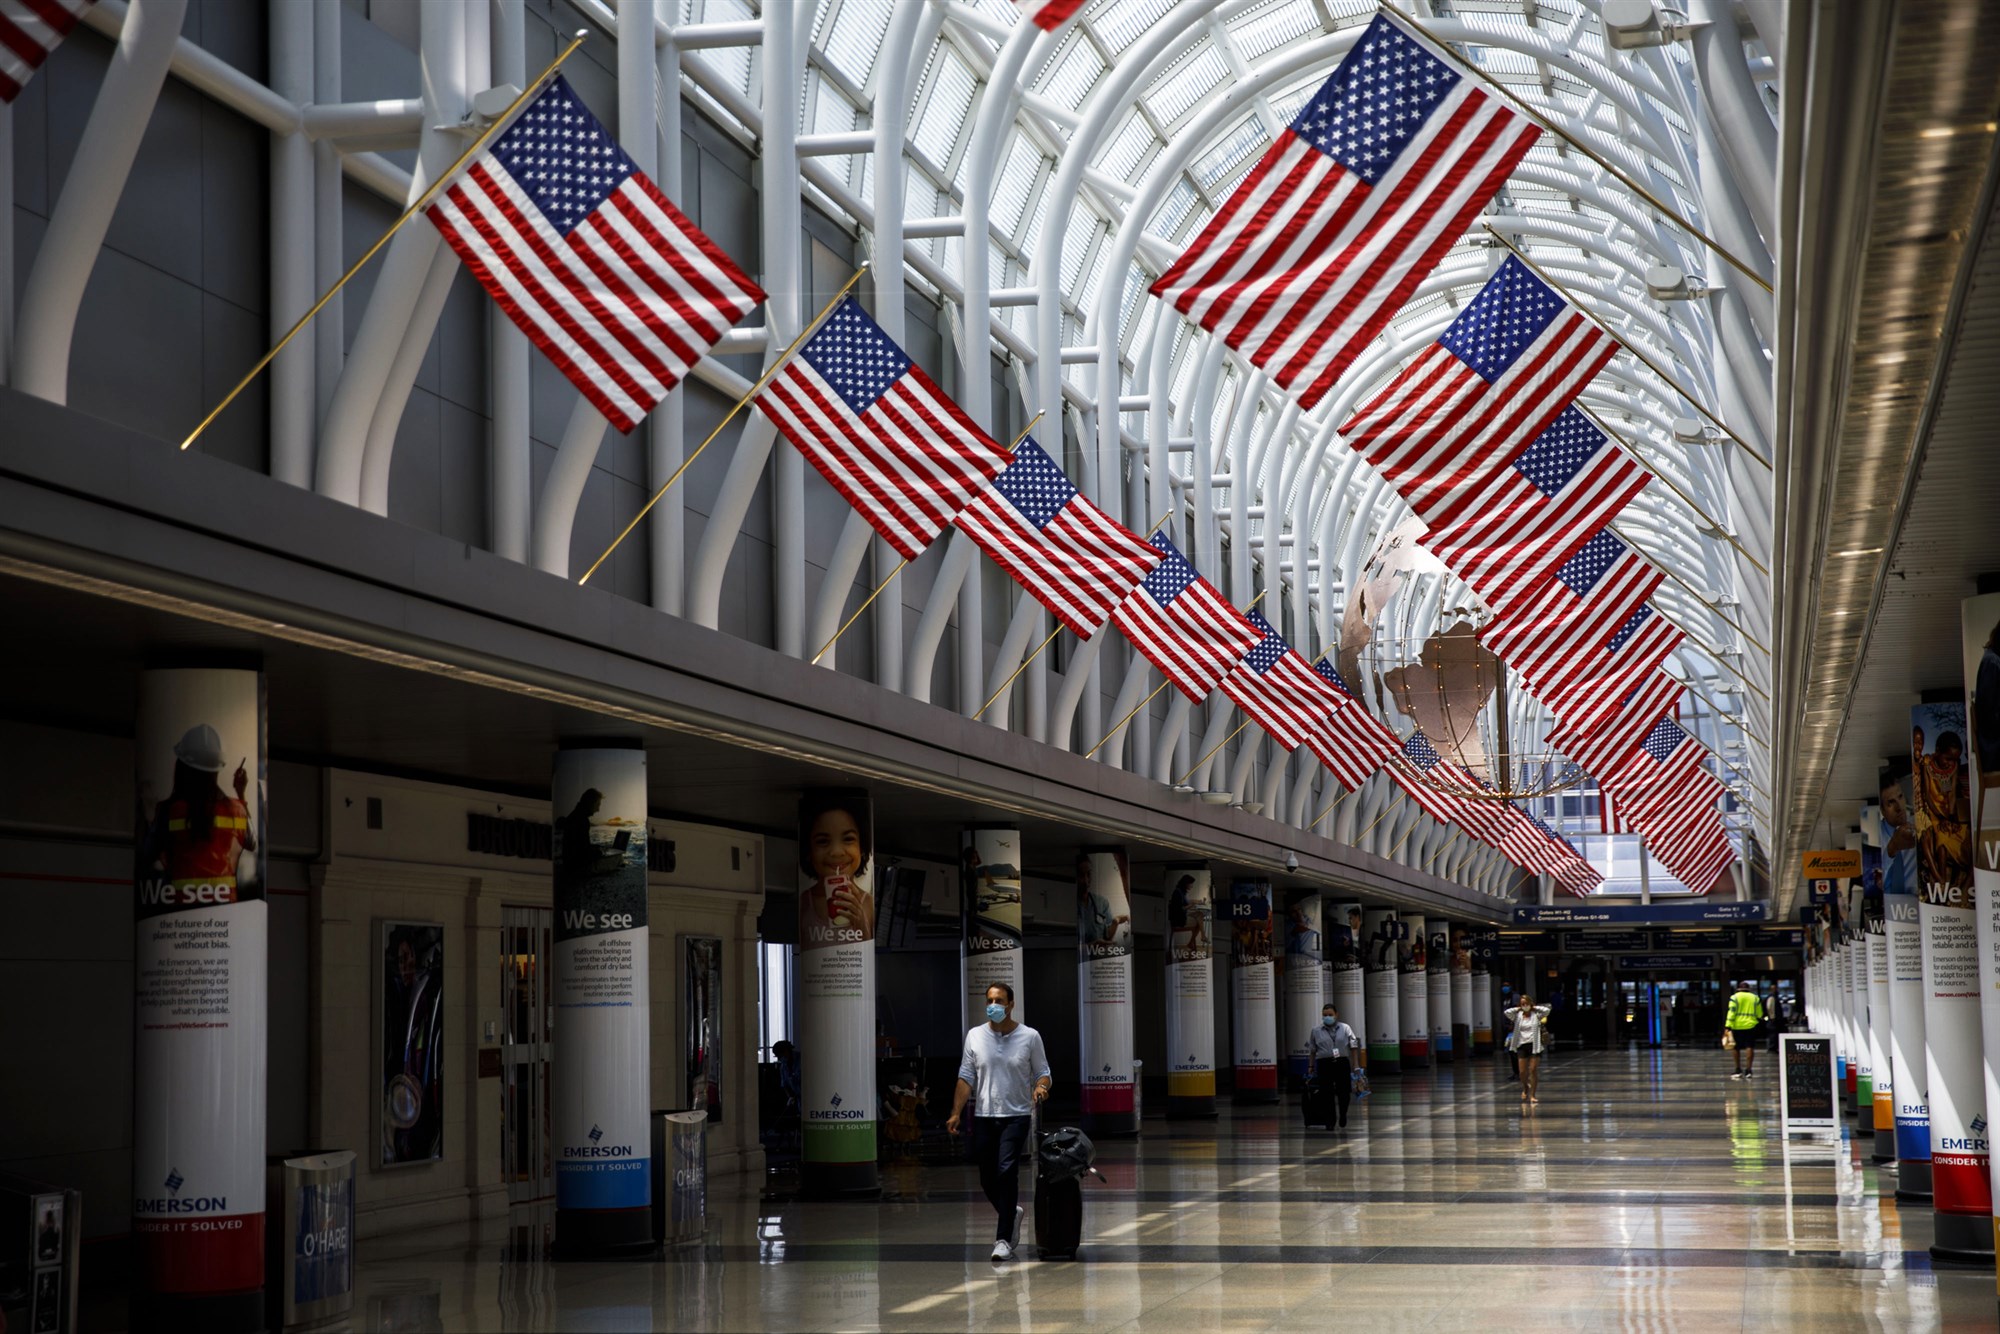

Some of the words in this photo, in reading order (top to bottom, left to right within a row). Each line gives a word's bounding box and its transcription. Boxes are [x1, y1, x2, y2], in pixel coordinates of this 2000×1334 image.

[1808, 857, 1857, 868] Macaroni
[140, 878, 176, 904] We
[182, 882, 231, 904] see
[1926, 882, 1962, 903] We
[1233, 904, 1251, 915] H3
[1891, 904, 1917, 920] We
[174, 920, 202, 928] future
[204, 919, 213, 928] of
[214, 920, 229, 928] our
[564, 910, 595, 929] We
[600, 913, 632, 929] see
[1948, 924, 1973, 933] people
[153, 931, 177, 942] planet
[179, 929, 229, 940] engineered
[809, 926, 834, 942] We
[838, 928, 863, 941] see
[1932, 933, 1952, 942] having
[174, 941, 209, 949] without
[968, 936, 990, 949] We
[993, 938, 1014, 949] see
[1932, 941, 1954, 949] reliable
[1955, 941, 1969, 949] and
[1086, 944, 1105, 956] We
[1107, 946, 1125, 956] see
[1172, 948, 1189, 959] We
[1191, 950, 1206, 959] see
[1483, 948, 1491, 958] G
[1238, 954, 1254, 963] We
[1255, 955, 1270, 963] see
[184, 967, 229, 977] challenging
[162, 978, 215, 987] strengthening
[191, 988, 229, 996] engineers
[200, 997, 229, 1006] beyond
[1795, 1043, 1820, 1051] TRULY
[810, 1110, 864, 1119] EMERSON
[564, 1146, 631, 1158] EMERSON
[608, 1162, 642, 1170] SOLVED
[1934, 1156, 1978, 1166] CONSIDER
[136, 1196, 226, 1213] EMERSON
[174, 1222, 187, 1232] IT
[191, 1219, 243, 1231] SOLVED
[304, 1226, 347, 1257] O'HARE
